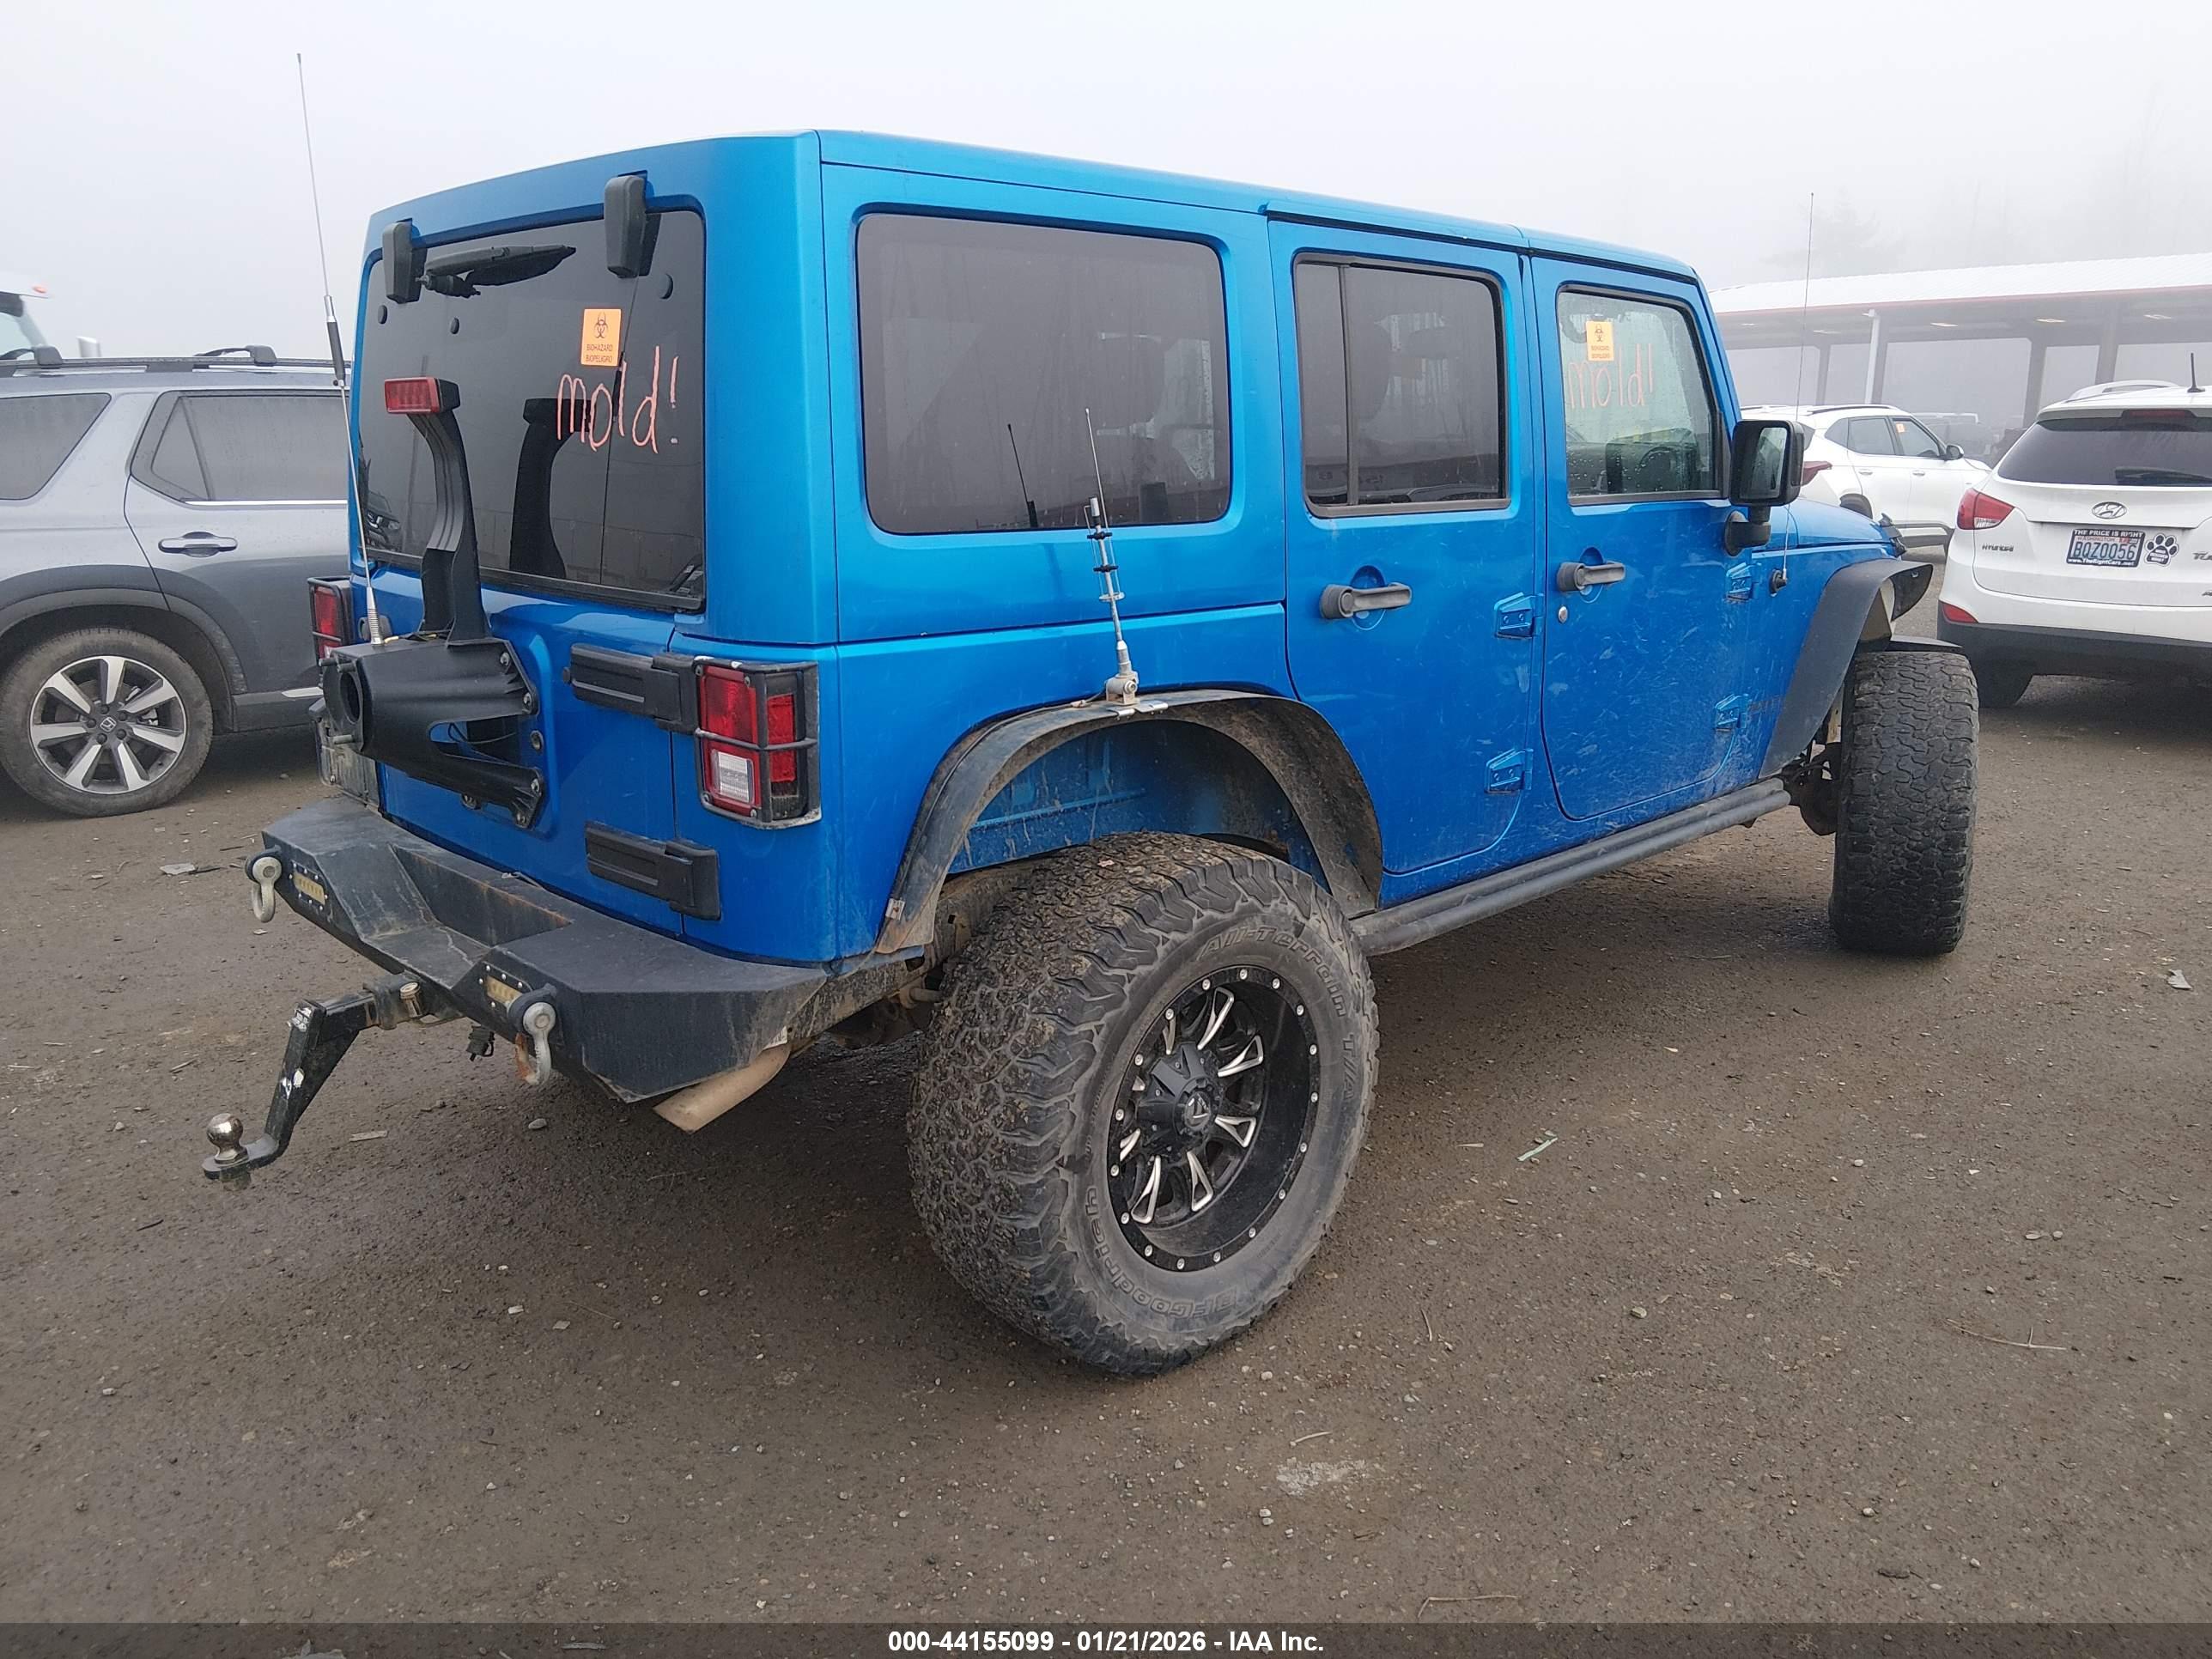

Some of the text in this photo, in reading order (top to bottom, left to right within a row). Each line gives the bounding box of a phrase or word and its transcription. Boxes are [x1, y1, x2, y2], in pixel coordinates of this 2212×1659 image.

[586, 343, 614, 353] BIOHAZARD
[586, 354, 613, 364] BIOPELIGRO
[556, 345, 679, 454] mold!
[2073, 541, 2137, 560] BQZ0056
